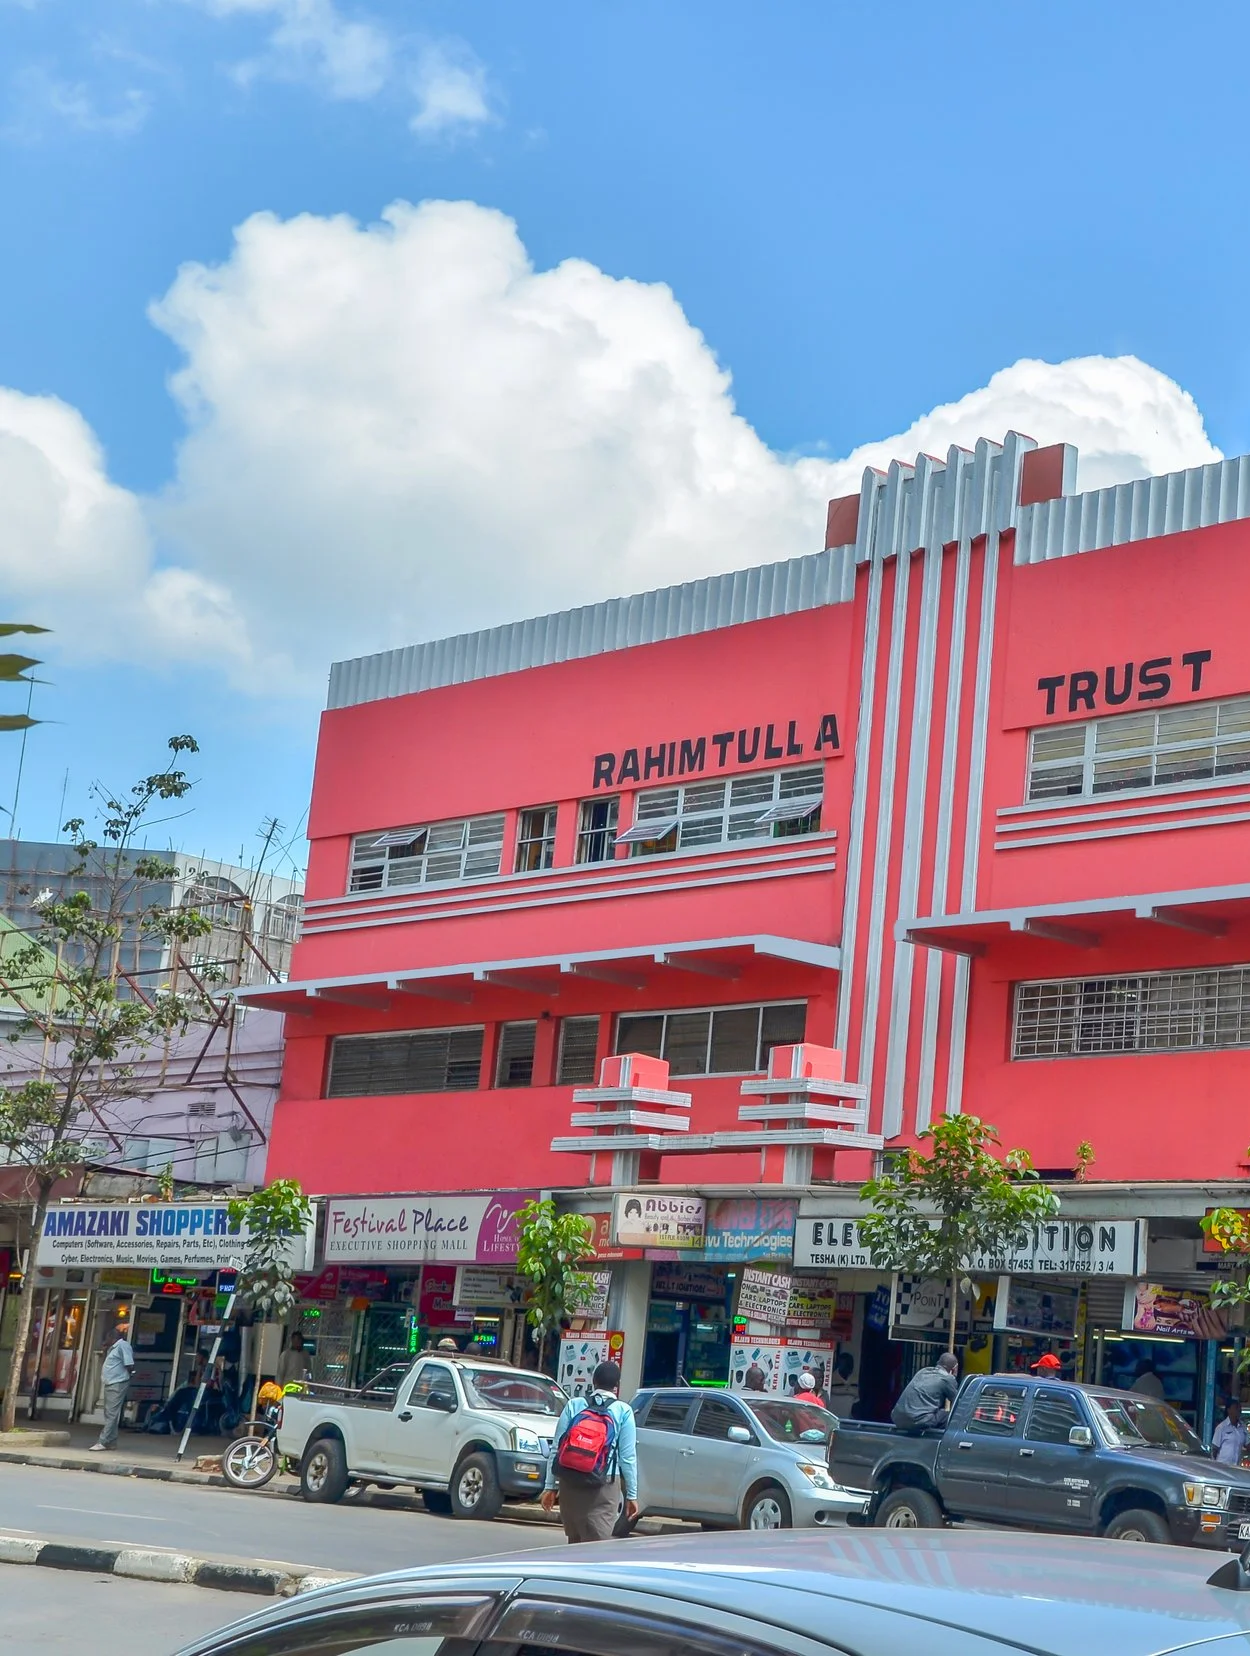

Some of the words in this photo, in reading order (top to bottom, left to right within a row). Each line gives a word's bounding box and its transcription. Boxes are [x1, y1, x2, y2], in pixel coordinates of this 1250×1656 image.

[1038, 650, 1212, 715] TRUST
[592, 713, 841, 790] RAHIMTULLA
[645, 1198, 702, 1214] Abbies
[44, 1210, 130, 1237] AMAZAKI
[332, 1207, 408, 1238] Festival
[413, 1208, 469, 1234] Place
[52, 1240, 83, 1249] Computers
[85, 1240, 114, 1249] (Software,
[116, 1240, 154, 1248] Accessories,
[156, 1240, 180, 1249] Repairs,
[182, 1240, 201, 1248] Parts,
[219, 1239, 247, 1250] Clothing
[330, 1240, 383, 1251] EXECUTIVE
[386, 1239, 437, 1250] SHOPPING
[441, 1239, 468, 1250] MALL
[722, 1231, 793, 1251] Technologies
[61, 1254, 78, 1264] Cyber,
[80, 1254, 114, 1264] Electronics,
[116, 1255, 135, 1264] Music,
[137, 1255, 159, 1265] Movies,
[161, 1255, 181, 1264] Games,
[184, 1254, 215, 1264] Perfumes,
[810, 1253, 836, 1265] TESHA
[837, 1254, 849, 1267] (K)
[851, 1254, 868, 1265] LTD.
[989, 1259, 1006, 1269] BOX
[1008, 1259, 1034, 1270] 57453
[1039, 1260, 1057, 1271] TEL:
[1059, 1260, 1091, 1271] 317652
[593, 1272, 610, 1285] CASH
[743, 1268, 773, 1285] INSTANT
[773, 1274, 791, 1289] CASH
[741, 1282, 750, 1291] ON
[758, 1295, 787, 1308] LAPTOPS
[805, 1303, 832, 1311] LAPTOPS
[744, 1301, 787, 1316] ELECTRONICS
[793, 1309, 831, 1318] ELECTRONICS
[1156, 1325, 1171, 1333] Nail
